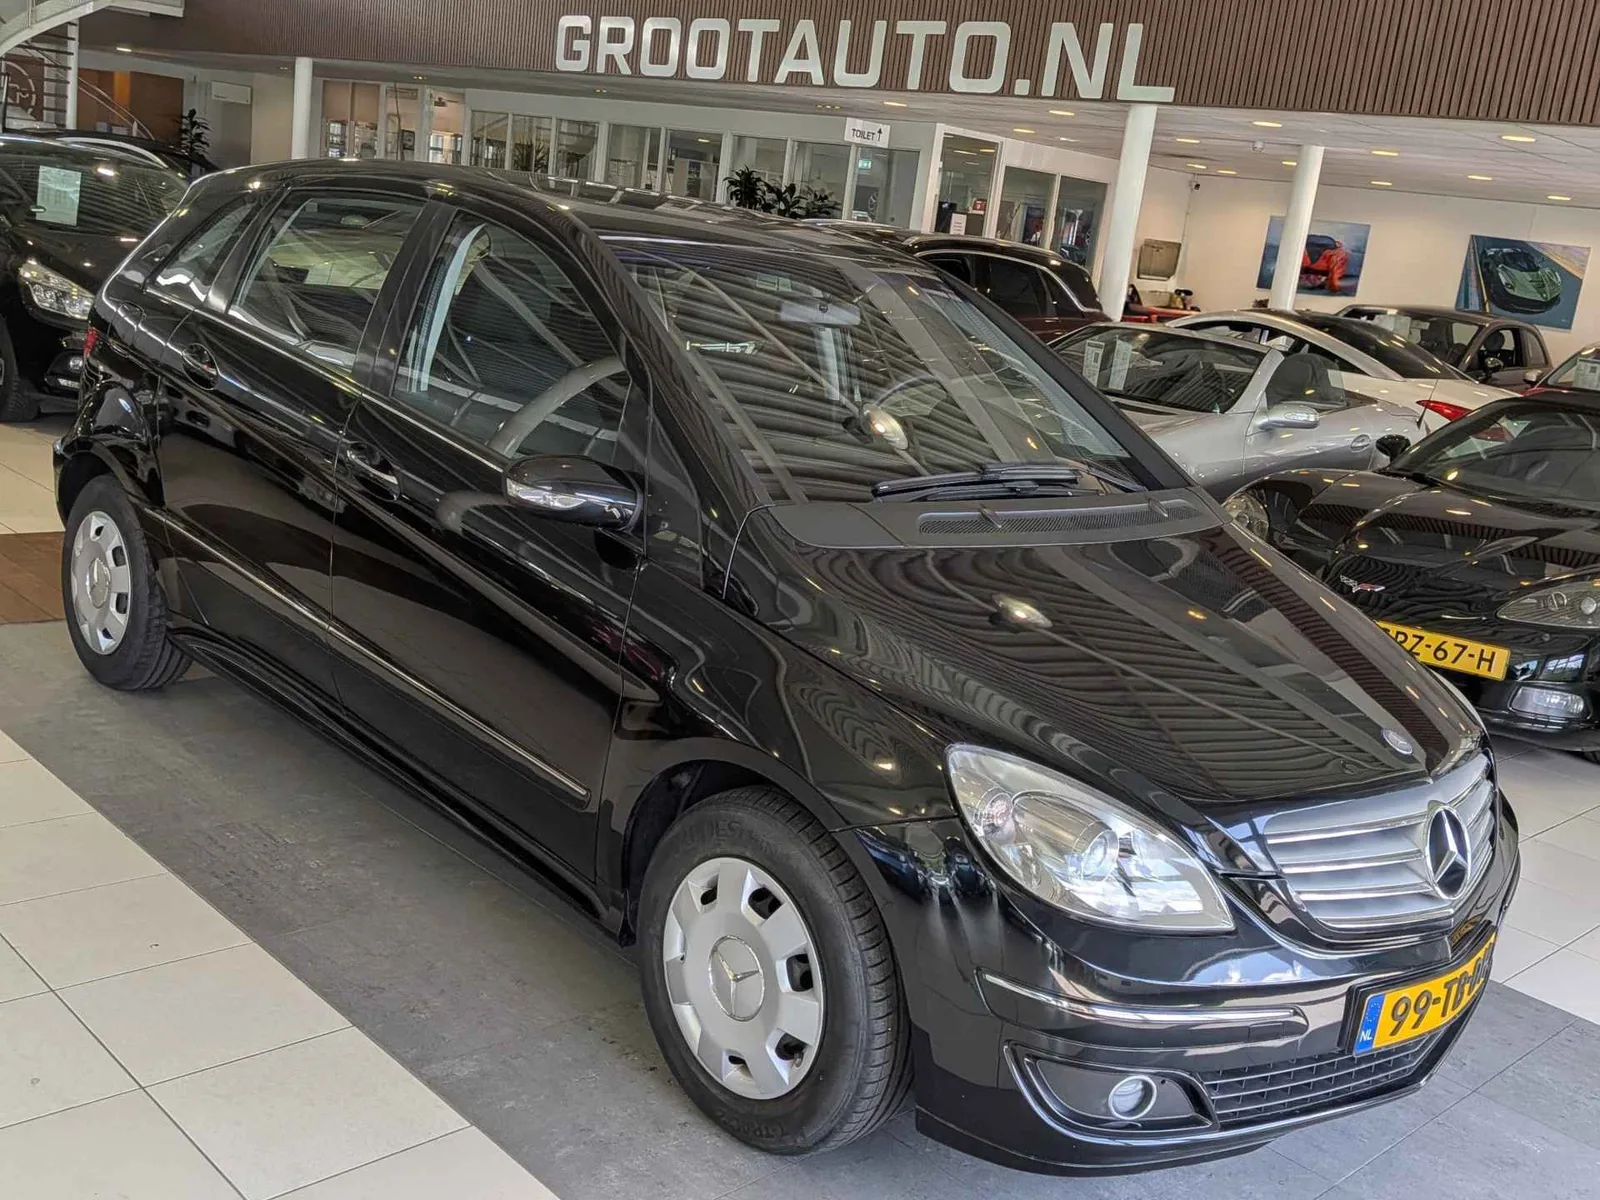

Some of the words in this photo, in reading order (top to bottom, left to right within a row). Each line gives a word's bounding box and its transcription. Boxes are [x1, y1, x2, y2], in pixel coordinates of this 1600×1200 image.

[555, 14, 1176, 102] GROOTAUTO.NL
[851, 128, 876, 141] TOILET
[1359, 1028, 1373, 1043] NL
